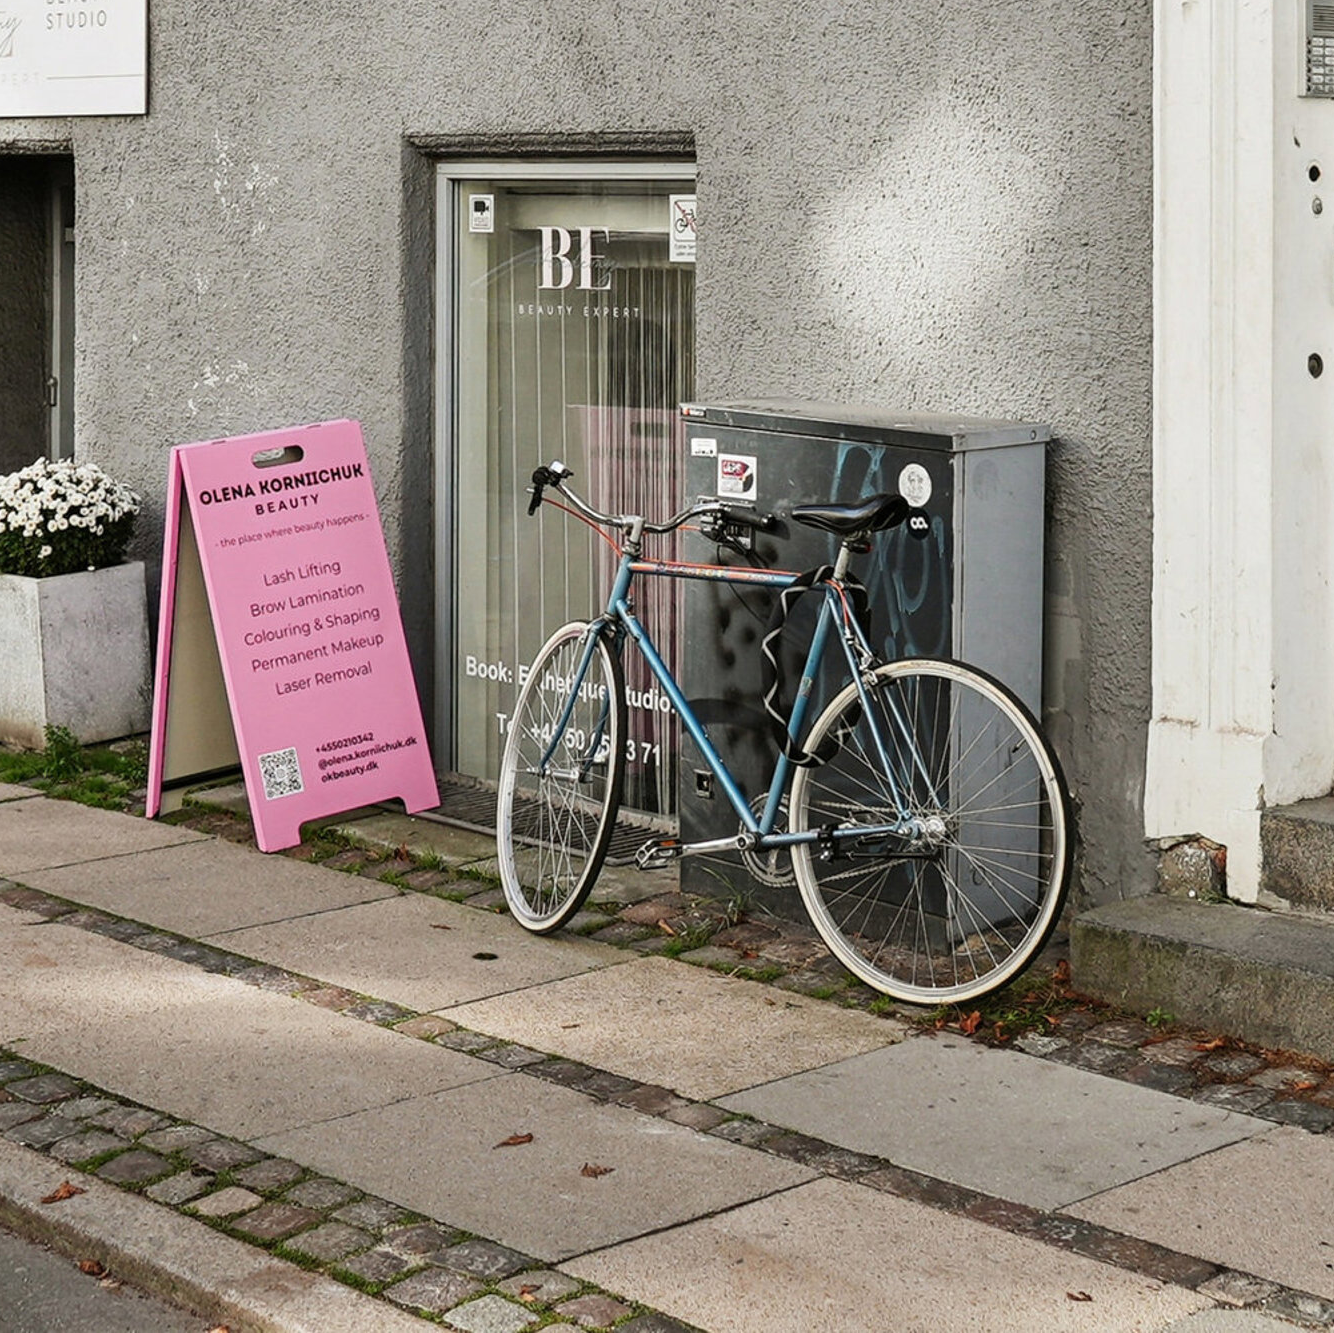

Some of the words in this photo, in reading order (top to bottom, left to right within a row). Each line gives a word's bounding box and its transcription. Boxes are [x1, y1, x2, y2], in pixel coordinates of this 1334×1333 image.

[46, 9, 108, 31] STUDIO
[537, 226, 611, 290] BE
[518, 304, 572, 315] BEAUTY
[583, 306, 639, 318] EXPERT
[200, 483, 256, 505] OLENA
[259, 463, 364, 495] KORNIICHUK
[255, 494, 319, 515] BEAUTY
[220, 535, 237, 548] the
[238, 531, 263, 546] place
[264, 526, 292, 539] where
[295, 519, 326, 534] beauty
[326, 513, 365, 528] happens
[263, 569, 296, 586] Lash
[298, 561, 341, 579] Lifting
[250, 600, 286, 617] Brow
[289, 584, 364, 609] Lamination
[244, 622, 311, 646] Colouring
[313, 617, 323, 631] &
[325, 607, 381, 629] Shaping
[251, 645, 328, 672] Permanent
[331, 633, 384, 654] Makeup
[275, 677, 312, 695] Laser
[315, 660, 372, 686] Removal
[466, 656, 513, 683] Book:
[625, 685, 676, 713] tudio.
[566, 728, 585, 751] 50
[641, 741, 661, 766] 71
[321, 761, 379, 783] okbeauty.dk
